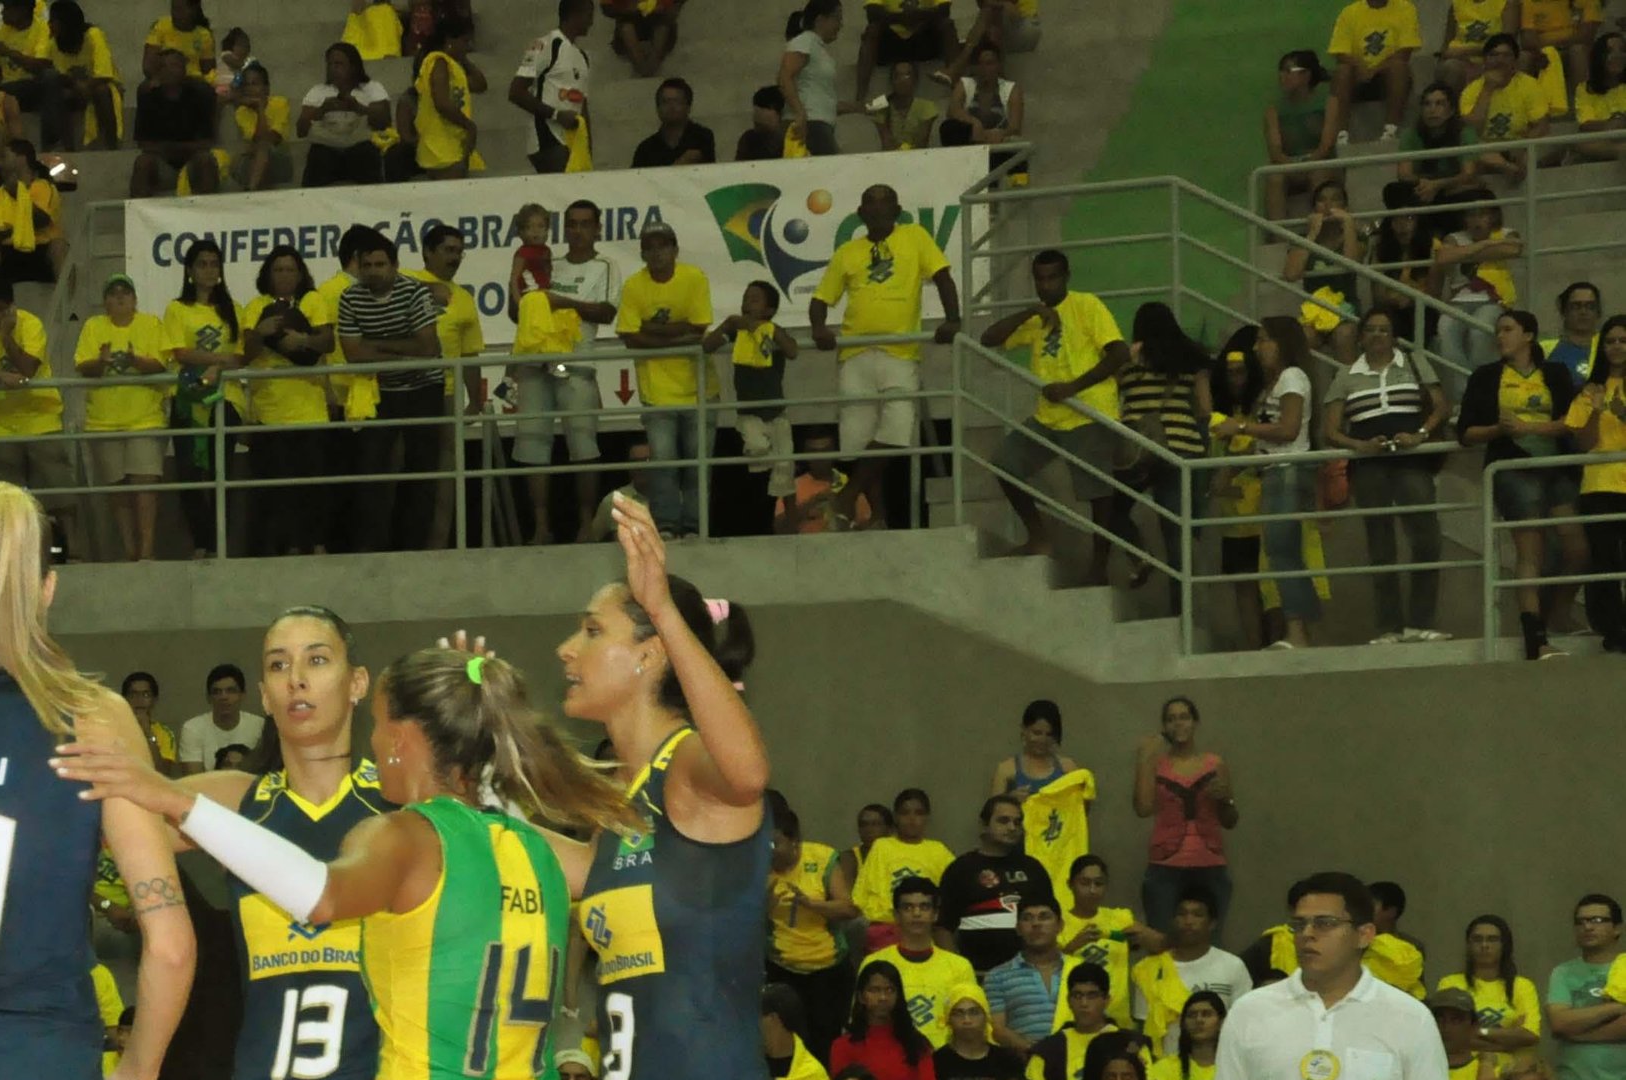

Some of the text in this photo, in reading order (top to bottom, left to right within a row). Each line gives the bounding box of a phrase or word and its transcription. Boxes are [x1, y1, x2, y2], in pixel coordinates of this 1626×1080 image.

[613, 851, 653, 870] BRA
[253, 946, 361, 971] BANCO DO BRAS
[463, 942, 560, 1077] 14
